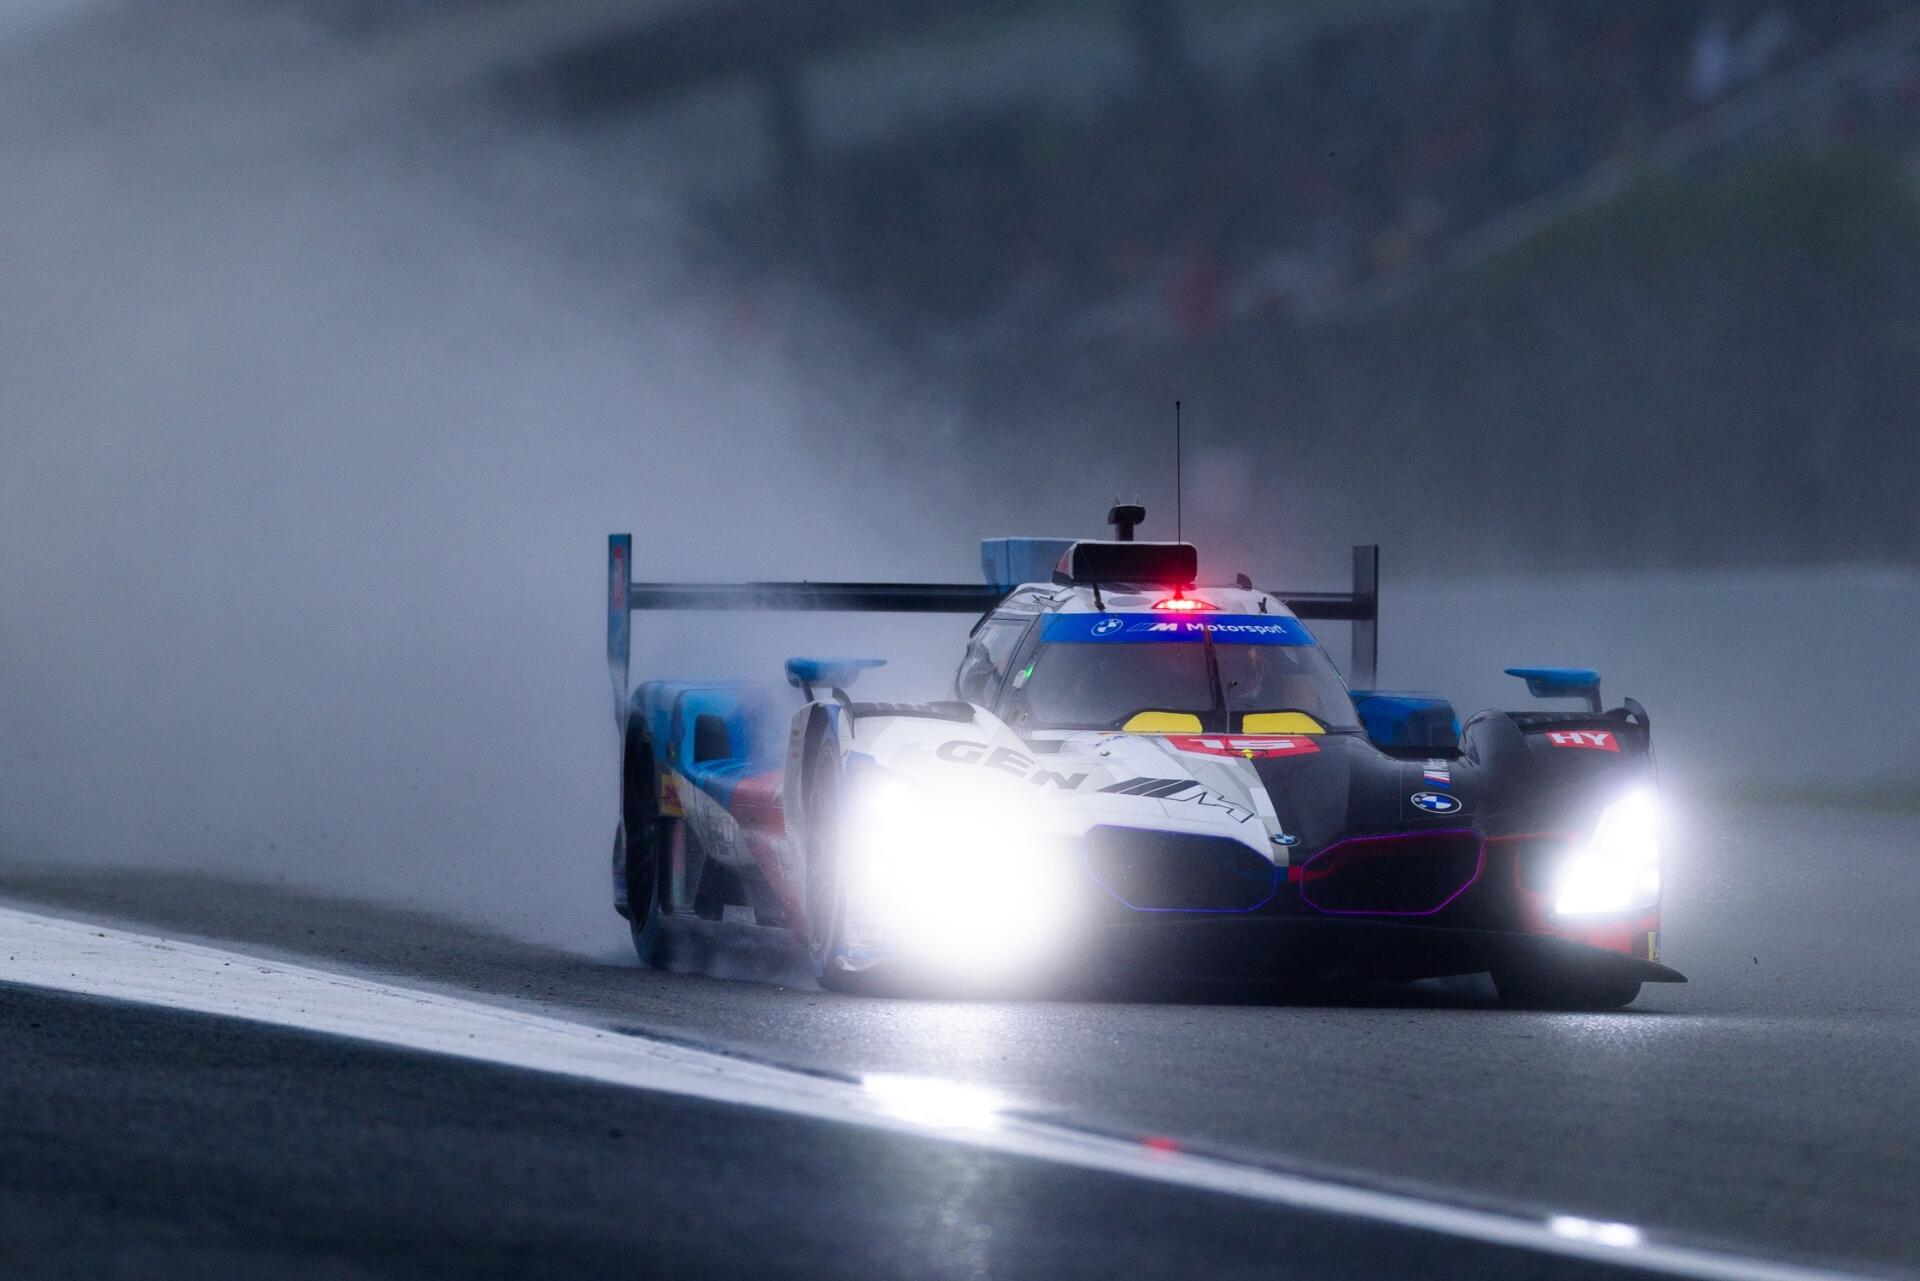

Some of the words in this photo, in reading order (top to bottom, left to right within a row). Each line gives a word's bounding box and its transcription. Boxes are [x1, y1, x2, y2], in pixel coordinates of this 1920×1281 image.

[1187, 623, 1287, 635] Motorsport
[1188, 739, 1296, 750] 15
[1551, 733, 1609, 746] HY
[936, 740, 1089, 790] GEN
